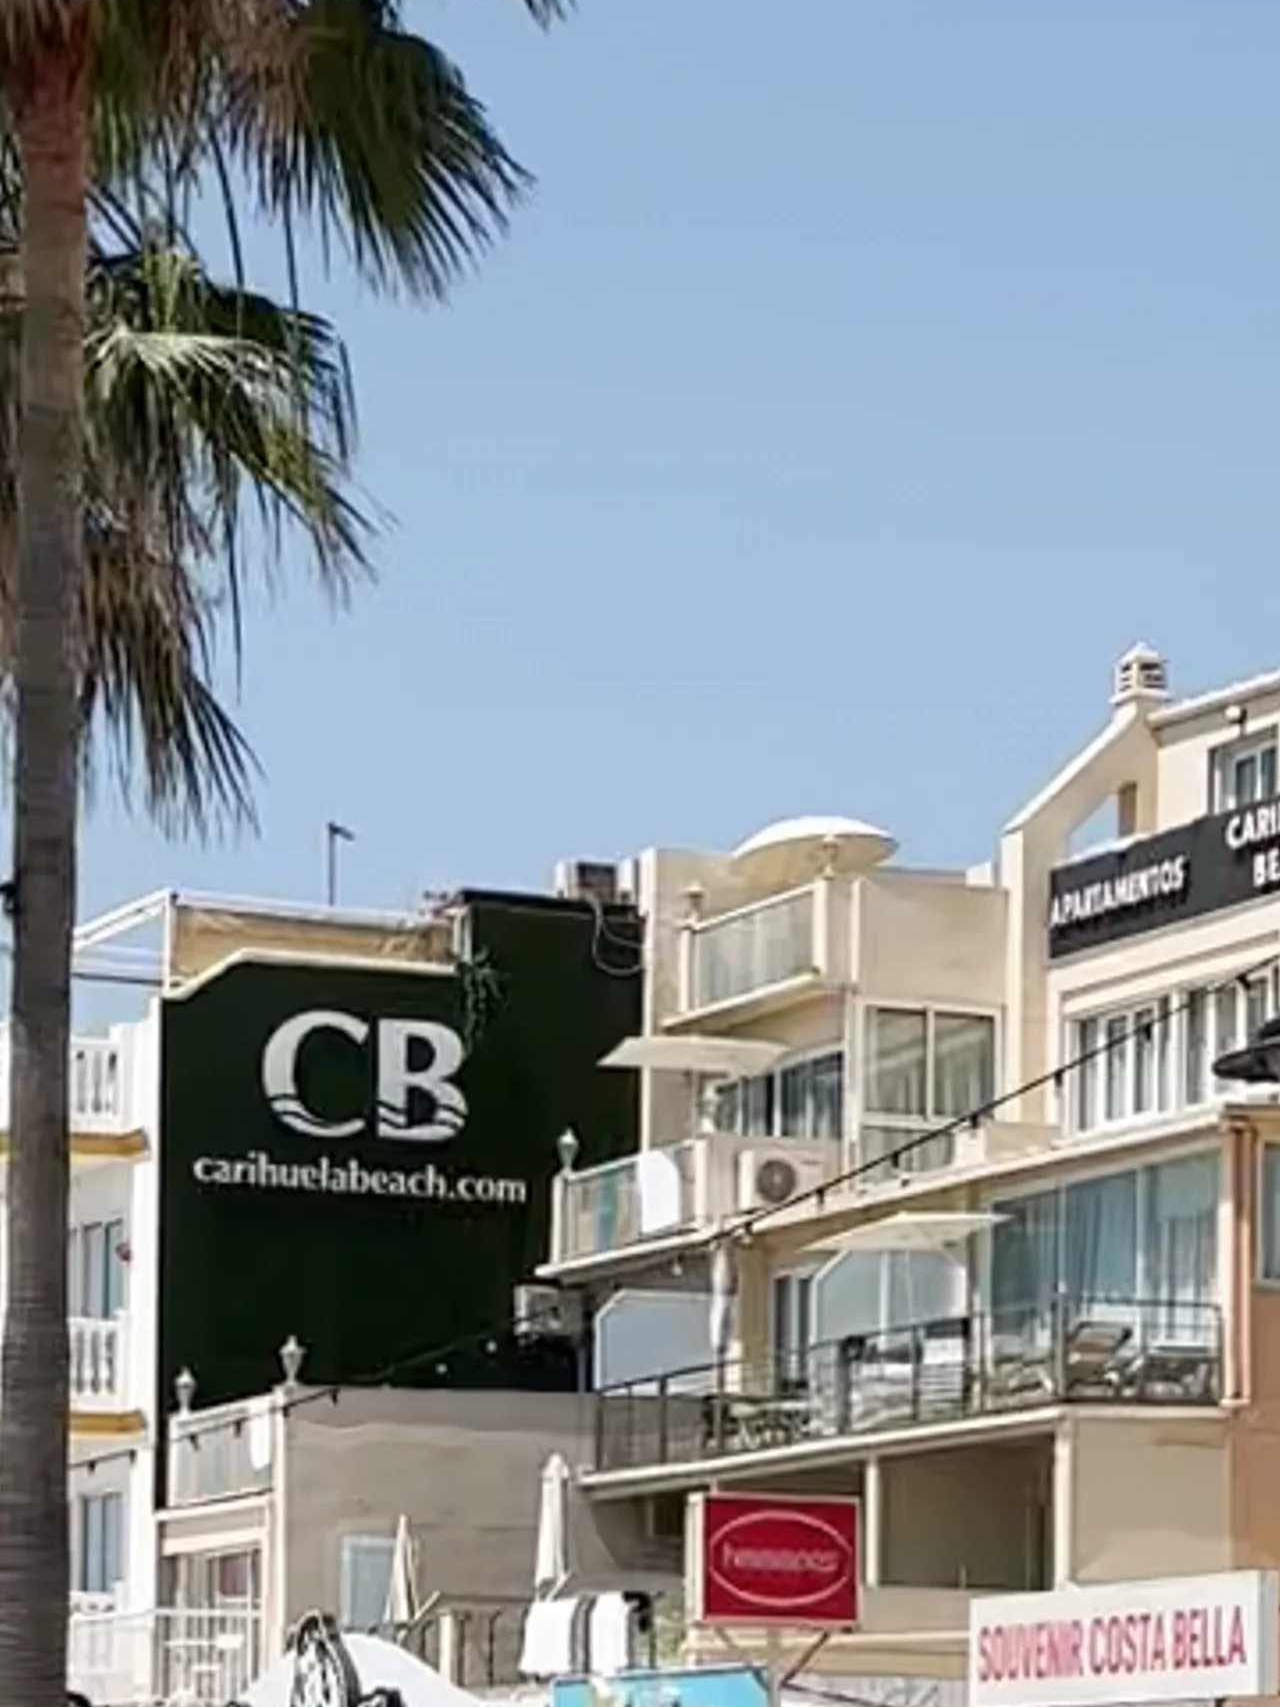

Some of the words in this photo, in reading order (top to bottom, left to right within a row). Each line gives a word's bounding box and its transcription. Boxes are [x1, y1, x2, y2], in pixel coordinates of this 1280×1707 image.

[1049, 855, 1186, 927] APARTAMENTOS
[261, 1009, 468, 1141] CB
[192, 1151, 527, 1203] carihuelabeach.com
[978, 1618, 1084, 1682] SOUVENIR
[1089, 1611, 1168, 1675] COSTA
[1173, 1604, 1247, 1669] BELLA
